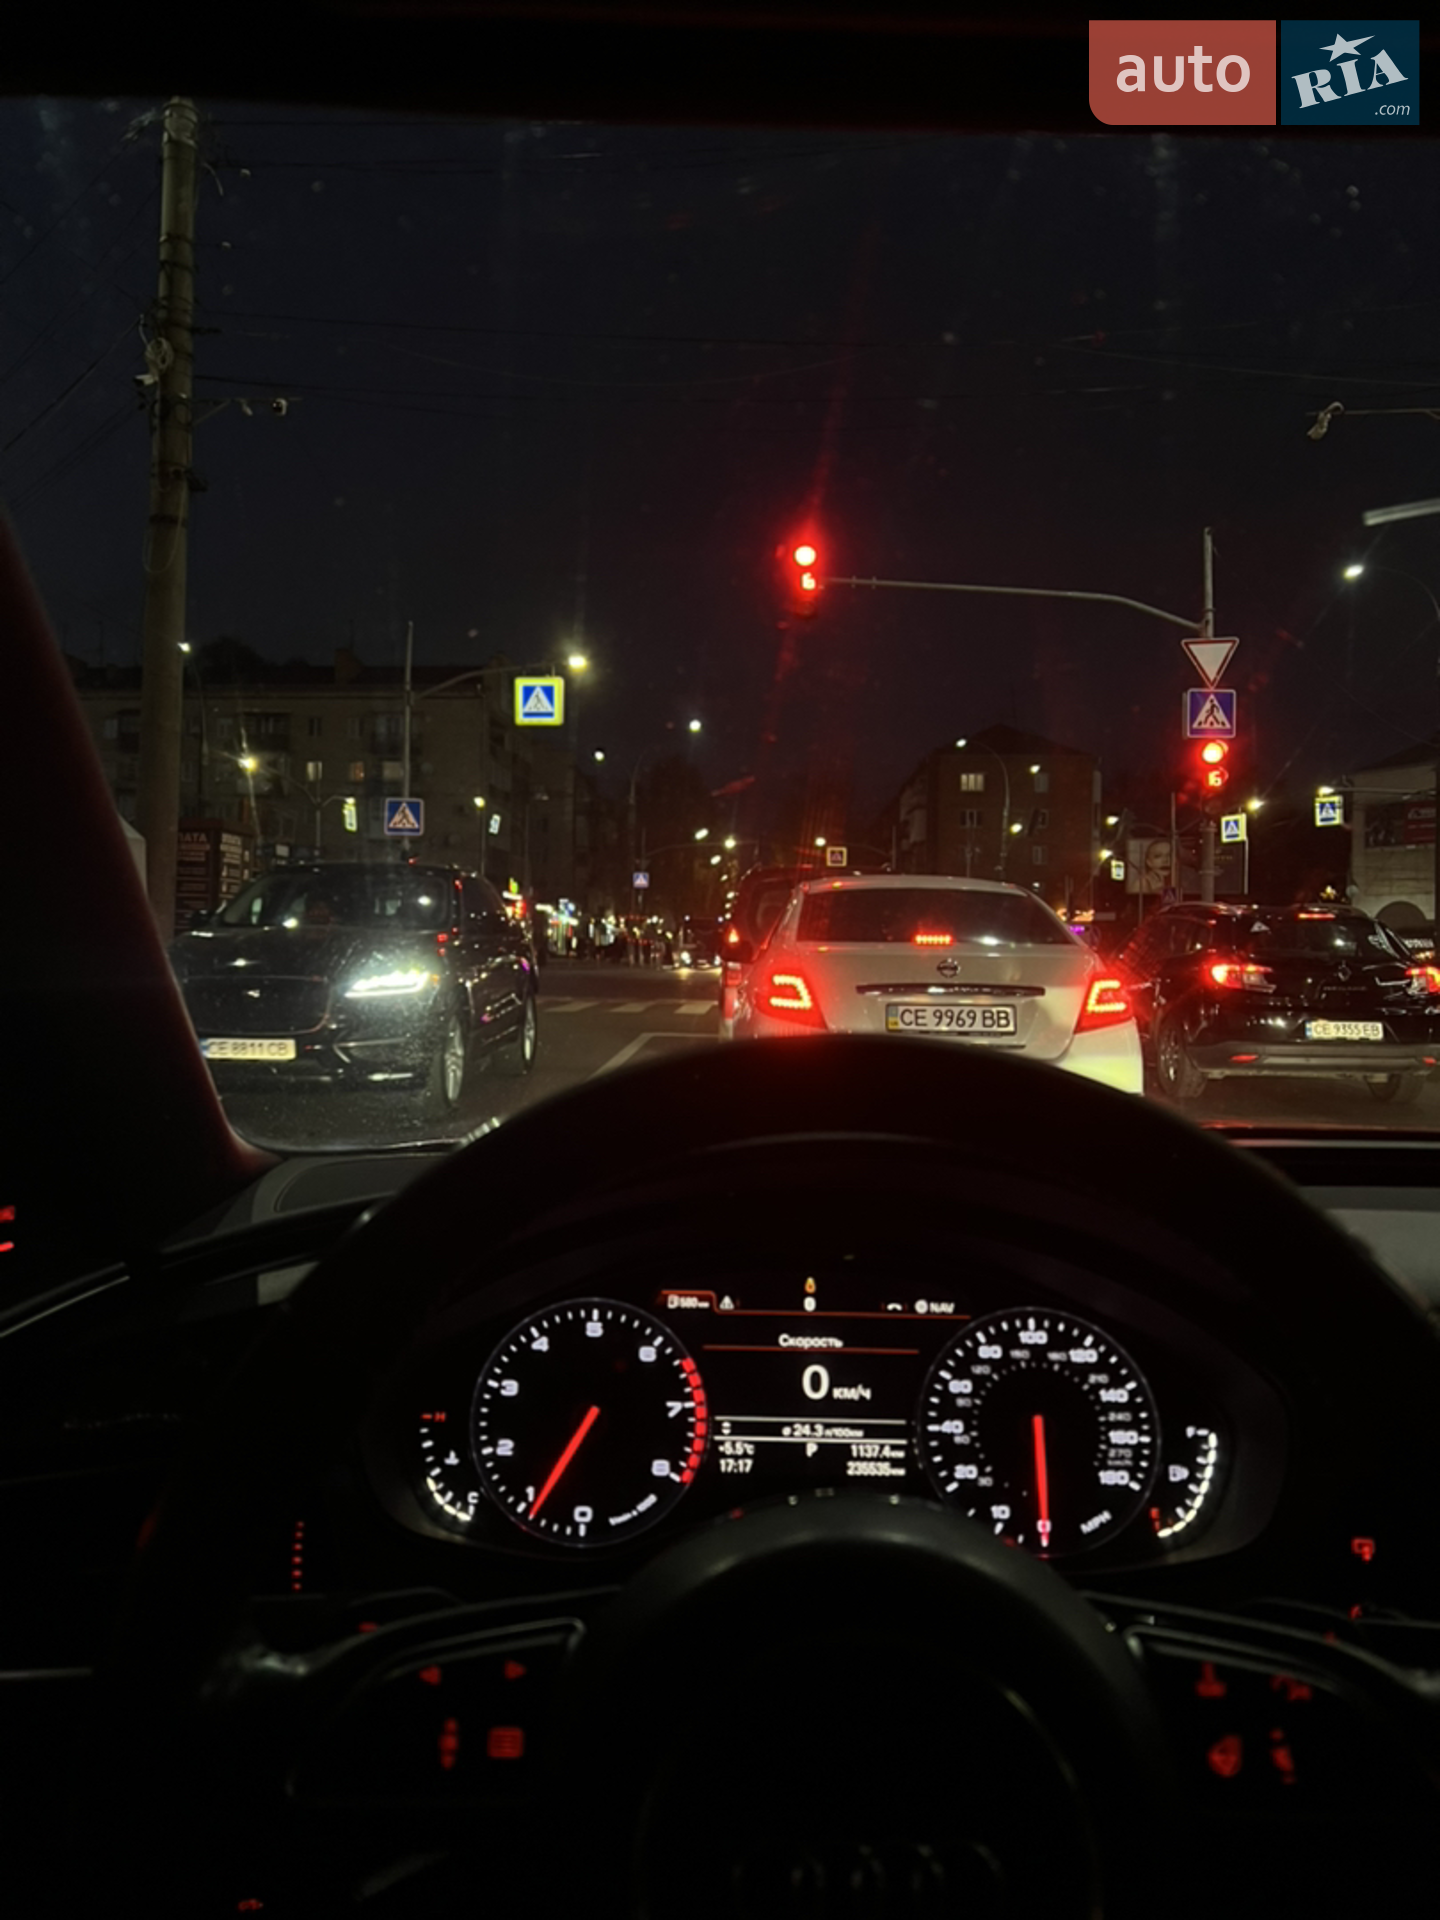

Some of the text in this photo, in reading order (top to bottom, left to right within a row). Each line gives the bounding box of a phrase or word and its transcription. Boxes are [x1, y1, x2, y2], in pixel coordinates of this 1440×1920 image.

[900, 1008, 1011, 1028] CE 9969 BB
[929, 1301, 956, 1315] NAV
[585, 1321, 604, 1338] 5
[1018, 1330, 1048, 1345] 100
[531, 1335, 550, 1352] 4
[777, 1332, 845, 1350] Скорость
[638, 1345, 658, 1362] 6
[977, 1344, 1003, 1359] 80
[500, 1379, 519, 1396] 3
[802, 1363, 830, 1401] 0
[1099, 1388, 1130, 1403] 140
[665, 1401, 683, 1418] 7
[1108, 1411, 1132, 1422] 240
[792, 1423, 824, 1438] 24.3
[941, 1419, 965, 1435] 40
[1108, 1429, 1139, 1445] 160
[496, 1439, 515, 1456] 2
[805, 1442, 818, 1458] P
[651, 1459, 671, 1477] 8
[720, 1457, 753, 1474] 17:17
[953, 1464, 979, 1480] 20
[526, 1486, 536, 1502] 1
[573, 1506, 593, 1524] 0
[991, 1504, 1011, 1520] 10
[1080, 1510, 1112, 1535] MPH
